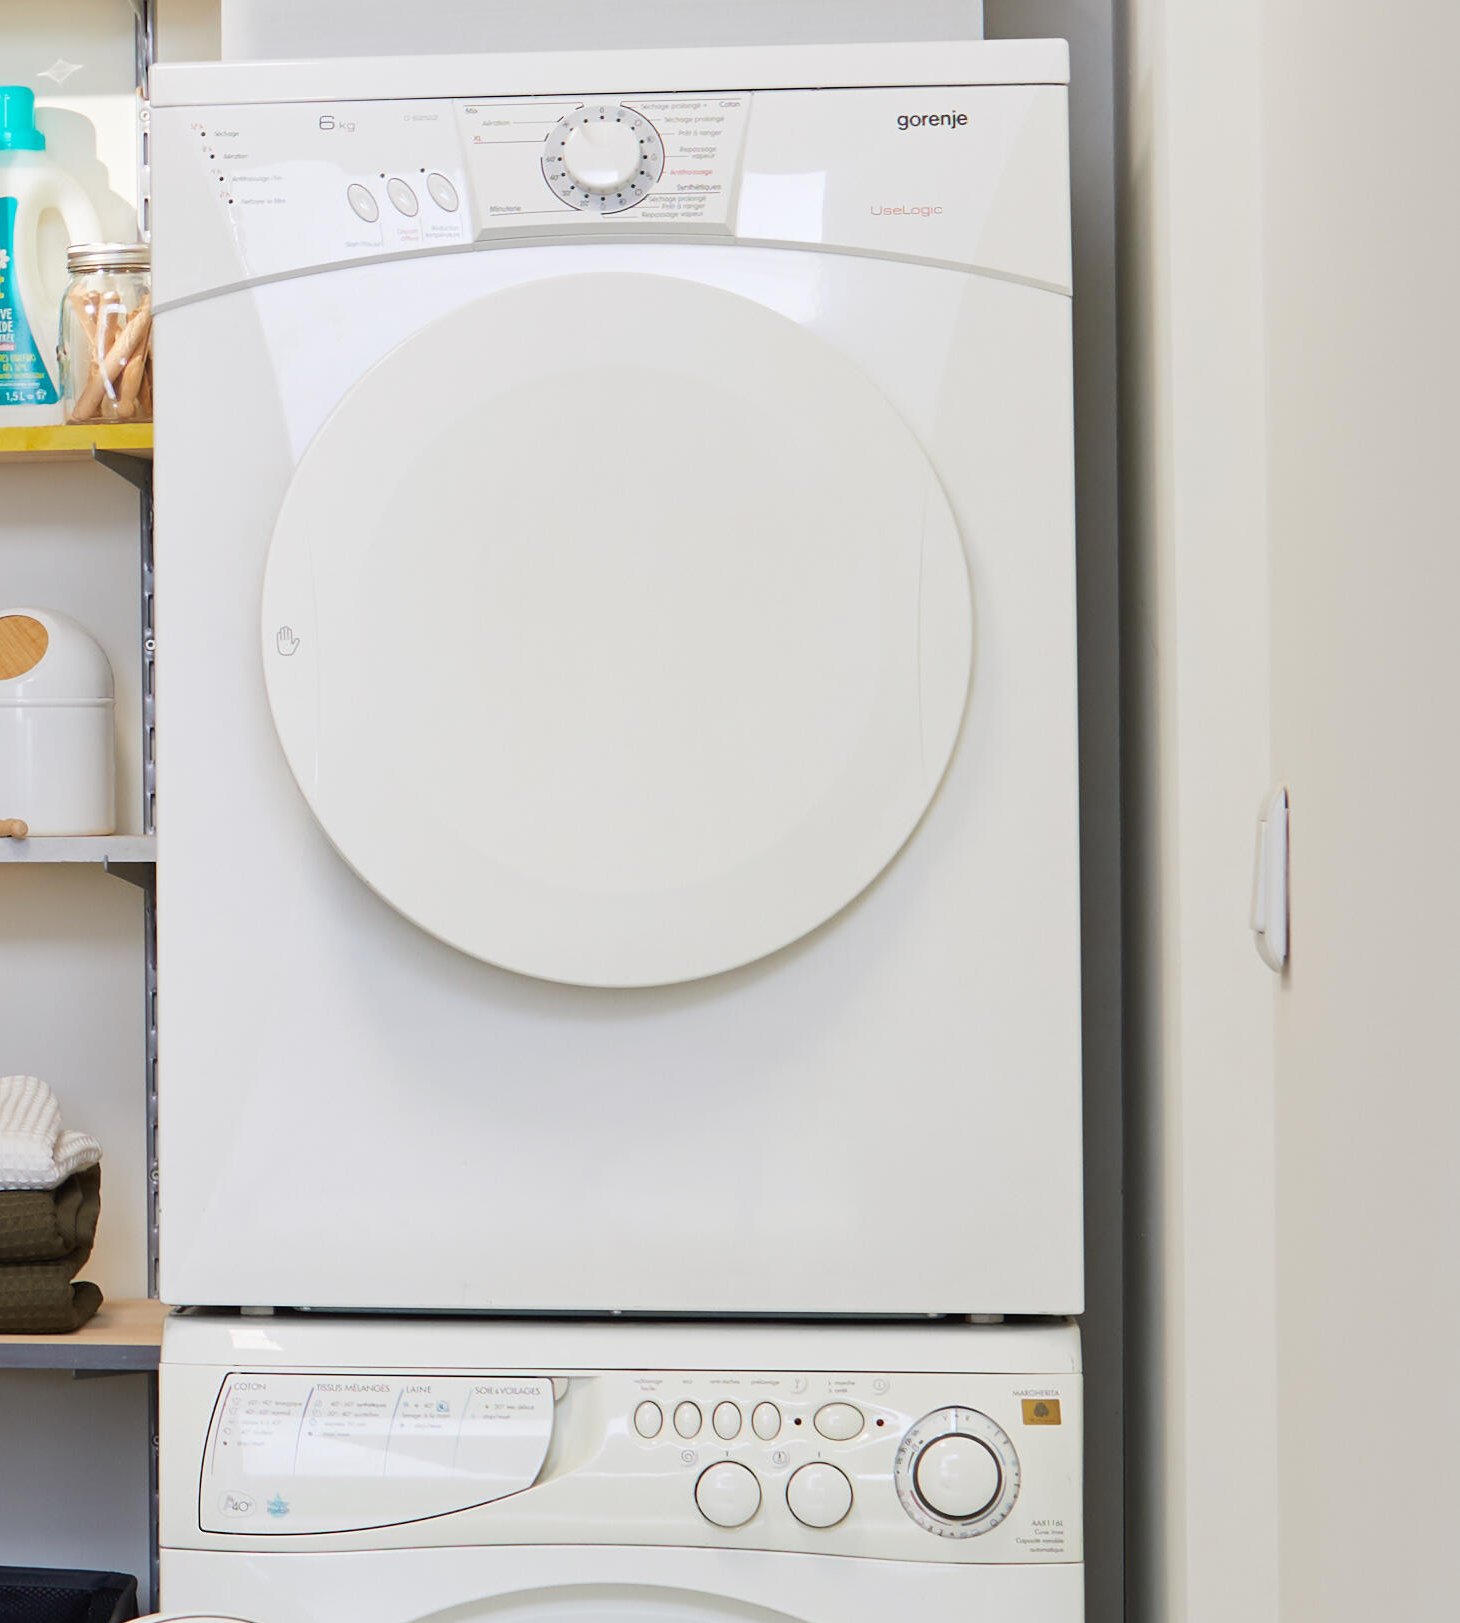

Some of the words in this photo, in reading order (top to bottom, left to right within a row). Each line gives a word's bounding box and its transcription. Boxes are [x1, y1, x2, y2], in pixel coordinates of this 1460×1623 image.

[318, 115, 336, 131] 6
[338, 121, 356, 133] kg
[896, 109, 968, 131] gorenje
[870, 204, 944, 218] UseLogic
[233, 1382, 267, 1391] COTON
[316, 1383, 344, 1393] TISSUS
[406, 1384, 433, 1394] LAINE
